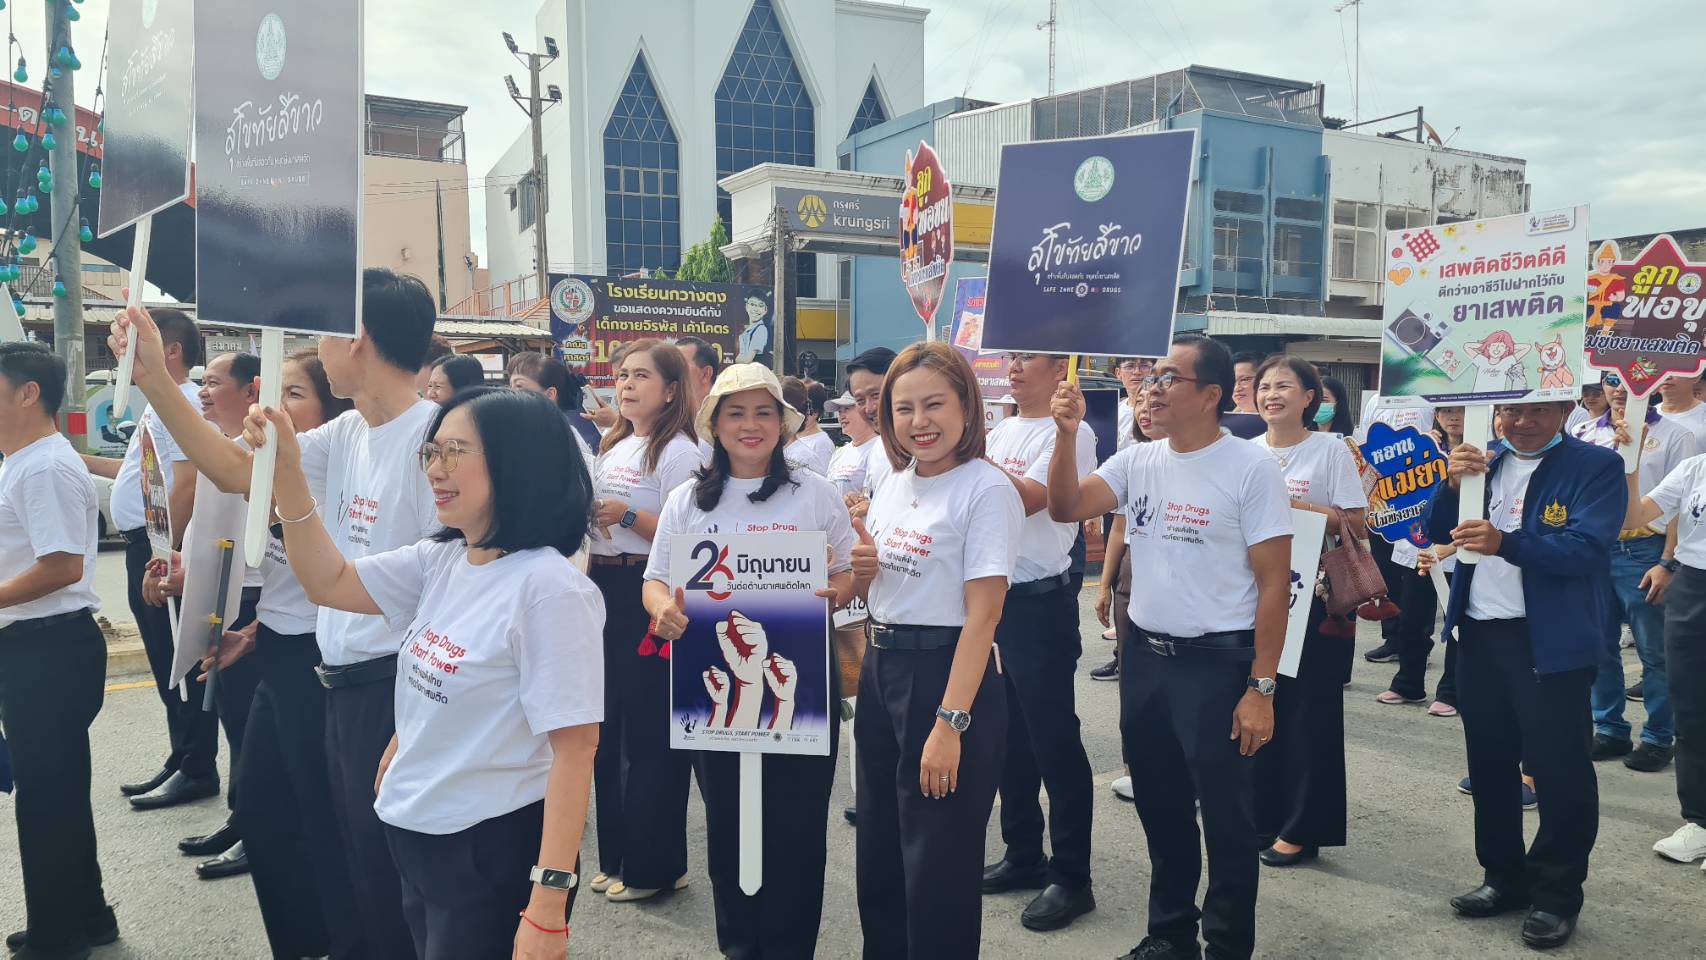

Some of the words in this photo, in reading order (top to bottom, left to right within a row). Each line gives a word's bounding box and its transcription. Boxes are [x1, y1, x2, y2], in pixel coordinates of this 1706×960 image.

[225, 92, 322, 173] สุโขทัยสีขาว
[833, 212, 890, 232] krungsri
[1028, 222, 1142, 286] สุโขทัยสีขาว
[1439, 244, 1566, 279] เสพติดชีวิตดีดี
[1632, 265, 1679, 295] ลูก
[613, 303, 722, 318] ขอแสดงความยินดีกับ
[1453, 291, 1565, 323] ยาเสพติด
[1584, 329, 1702, 355] ม่ยุ่งยาเสพติด
[1371, 437, 1416, 465] หลาน
[1378, 450, 1448, 500] แม่ย่า
[1167, 502, 1183, 513] Stop
[1185, 504, 1210, 516] Drugs
[1181, 515, 1210, 526] Power
[747, 524, 769, 532] Stop
[893, 527, 908, 540] Stop
[909, 530, 933, 545] Drugs
[884, 538, 902, 549] Start
[903, 542, 931, 557] Power
[685, 540, 735, 600] 26
[737, 554, 811, 580] มิถุนายน
[727, 580, 811, 591] วันต่อต้านยาเสพติดโลก
[439, 635, 466, 659] Drugs
